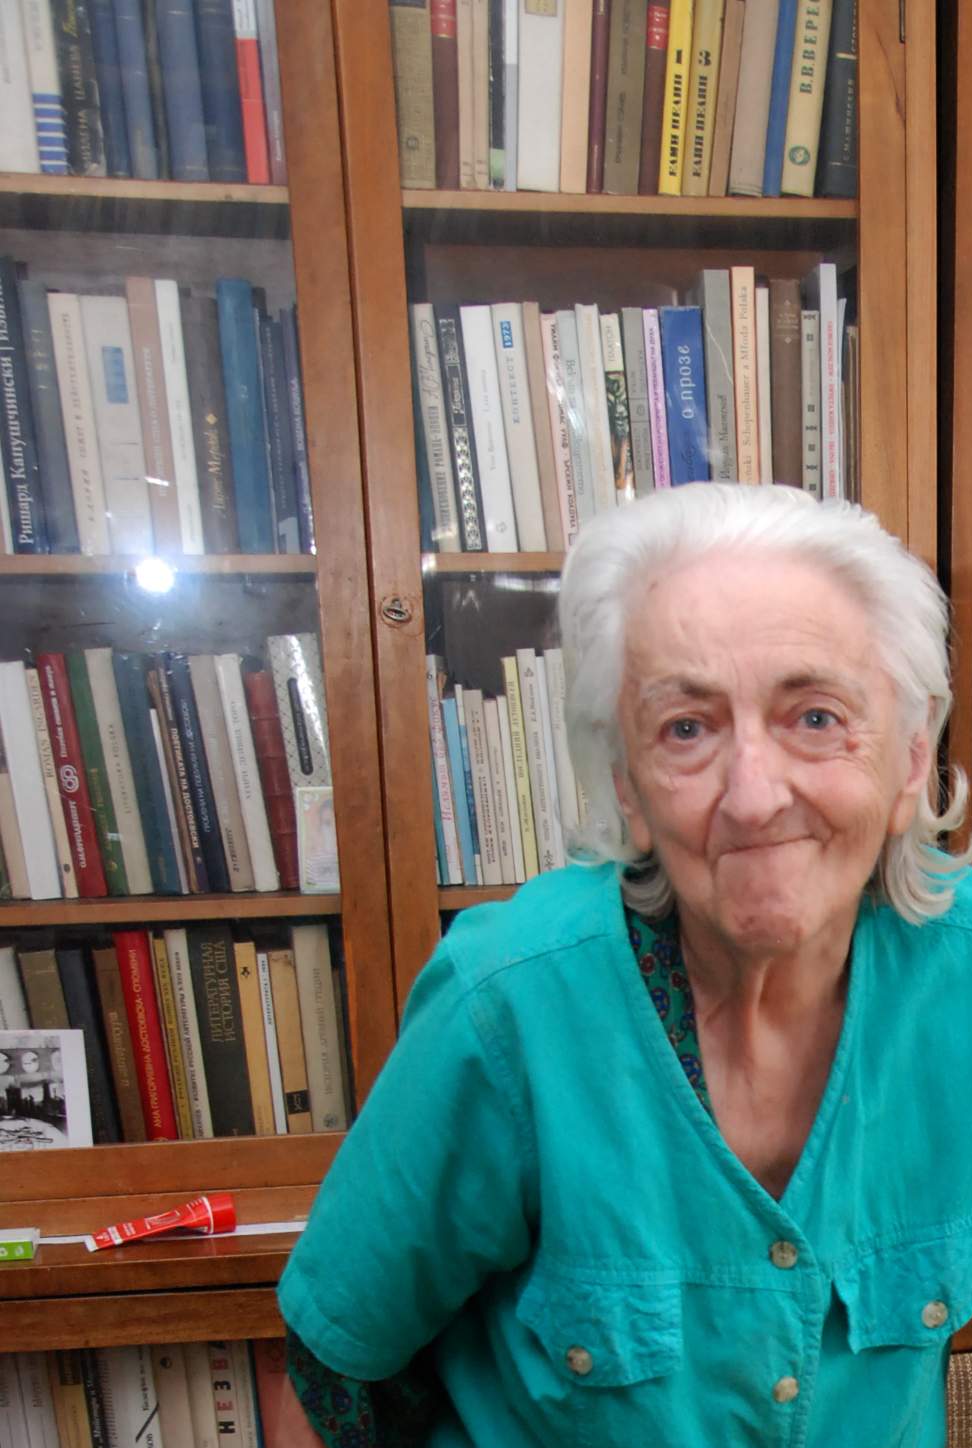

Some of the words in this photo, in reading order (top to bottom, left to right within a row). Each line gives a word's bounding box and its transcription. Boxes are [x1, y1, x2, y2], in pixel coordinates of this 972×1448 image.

[738, 285, 749, 321] Polska
[502, 321, 514, 348] 1973
[0, 356, 27, 480] Капушчински
[741, 375, 754, 448] Schopenhauer
[15, 484, 35, 545] Ришард
[40, 738, 55, 779] ROMAN
[127, 949, 143, 993] СПОМЕНИ
[212, 940, 228, 974] США
[199, 942, 224, 1043] ЛИТЕРАТУРНАЯ
[219, 977, 236, 1042] ИСТОРИЯ
[135, 998, 151, 1053] ДОСТОЕВСКА
[142, 1053, 159, 1110] ГРИГОРИЕВНА
[149, 1108, 162, 1129] АНА
